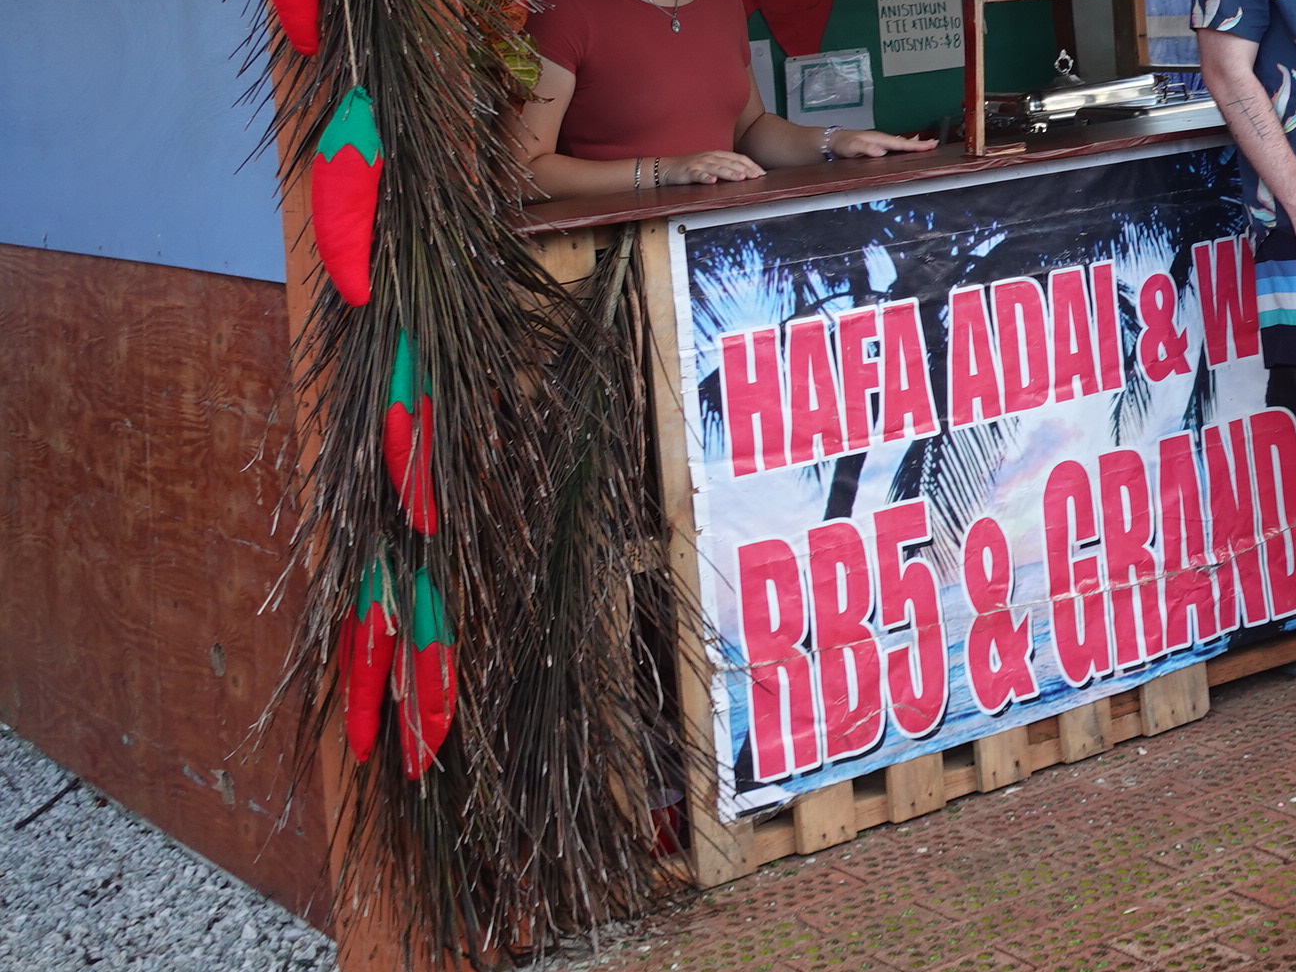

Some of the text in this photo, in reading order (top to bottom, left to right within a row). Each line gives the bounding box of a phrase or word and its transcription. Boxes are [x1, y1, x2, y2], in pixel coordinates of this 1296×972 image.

[718, 297, 940, 479] HAFA
[949, 261, 1124, 432] ADAI
[1136, 270, 1191, 383] &
[735, 498, 950, 785] RB5
[961, 515, 1041, 716] &
